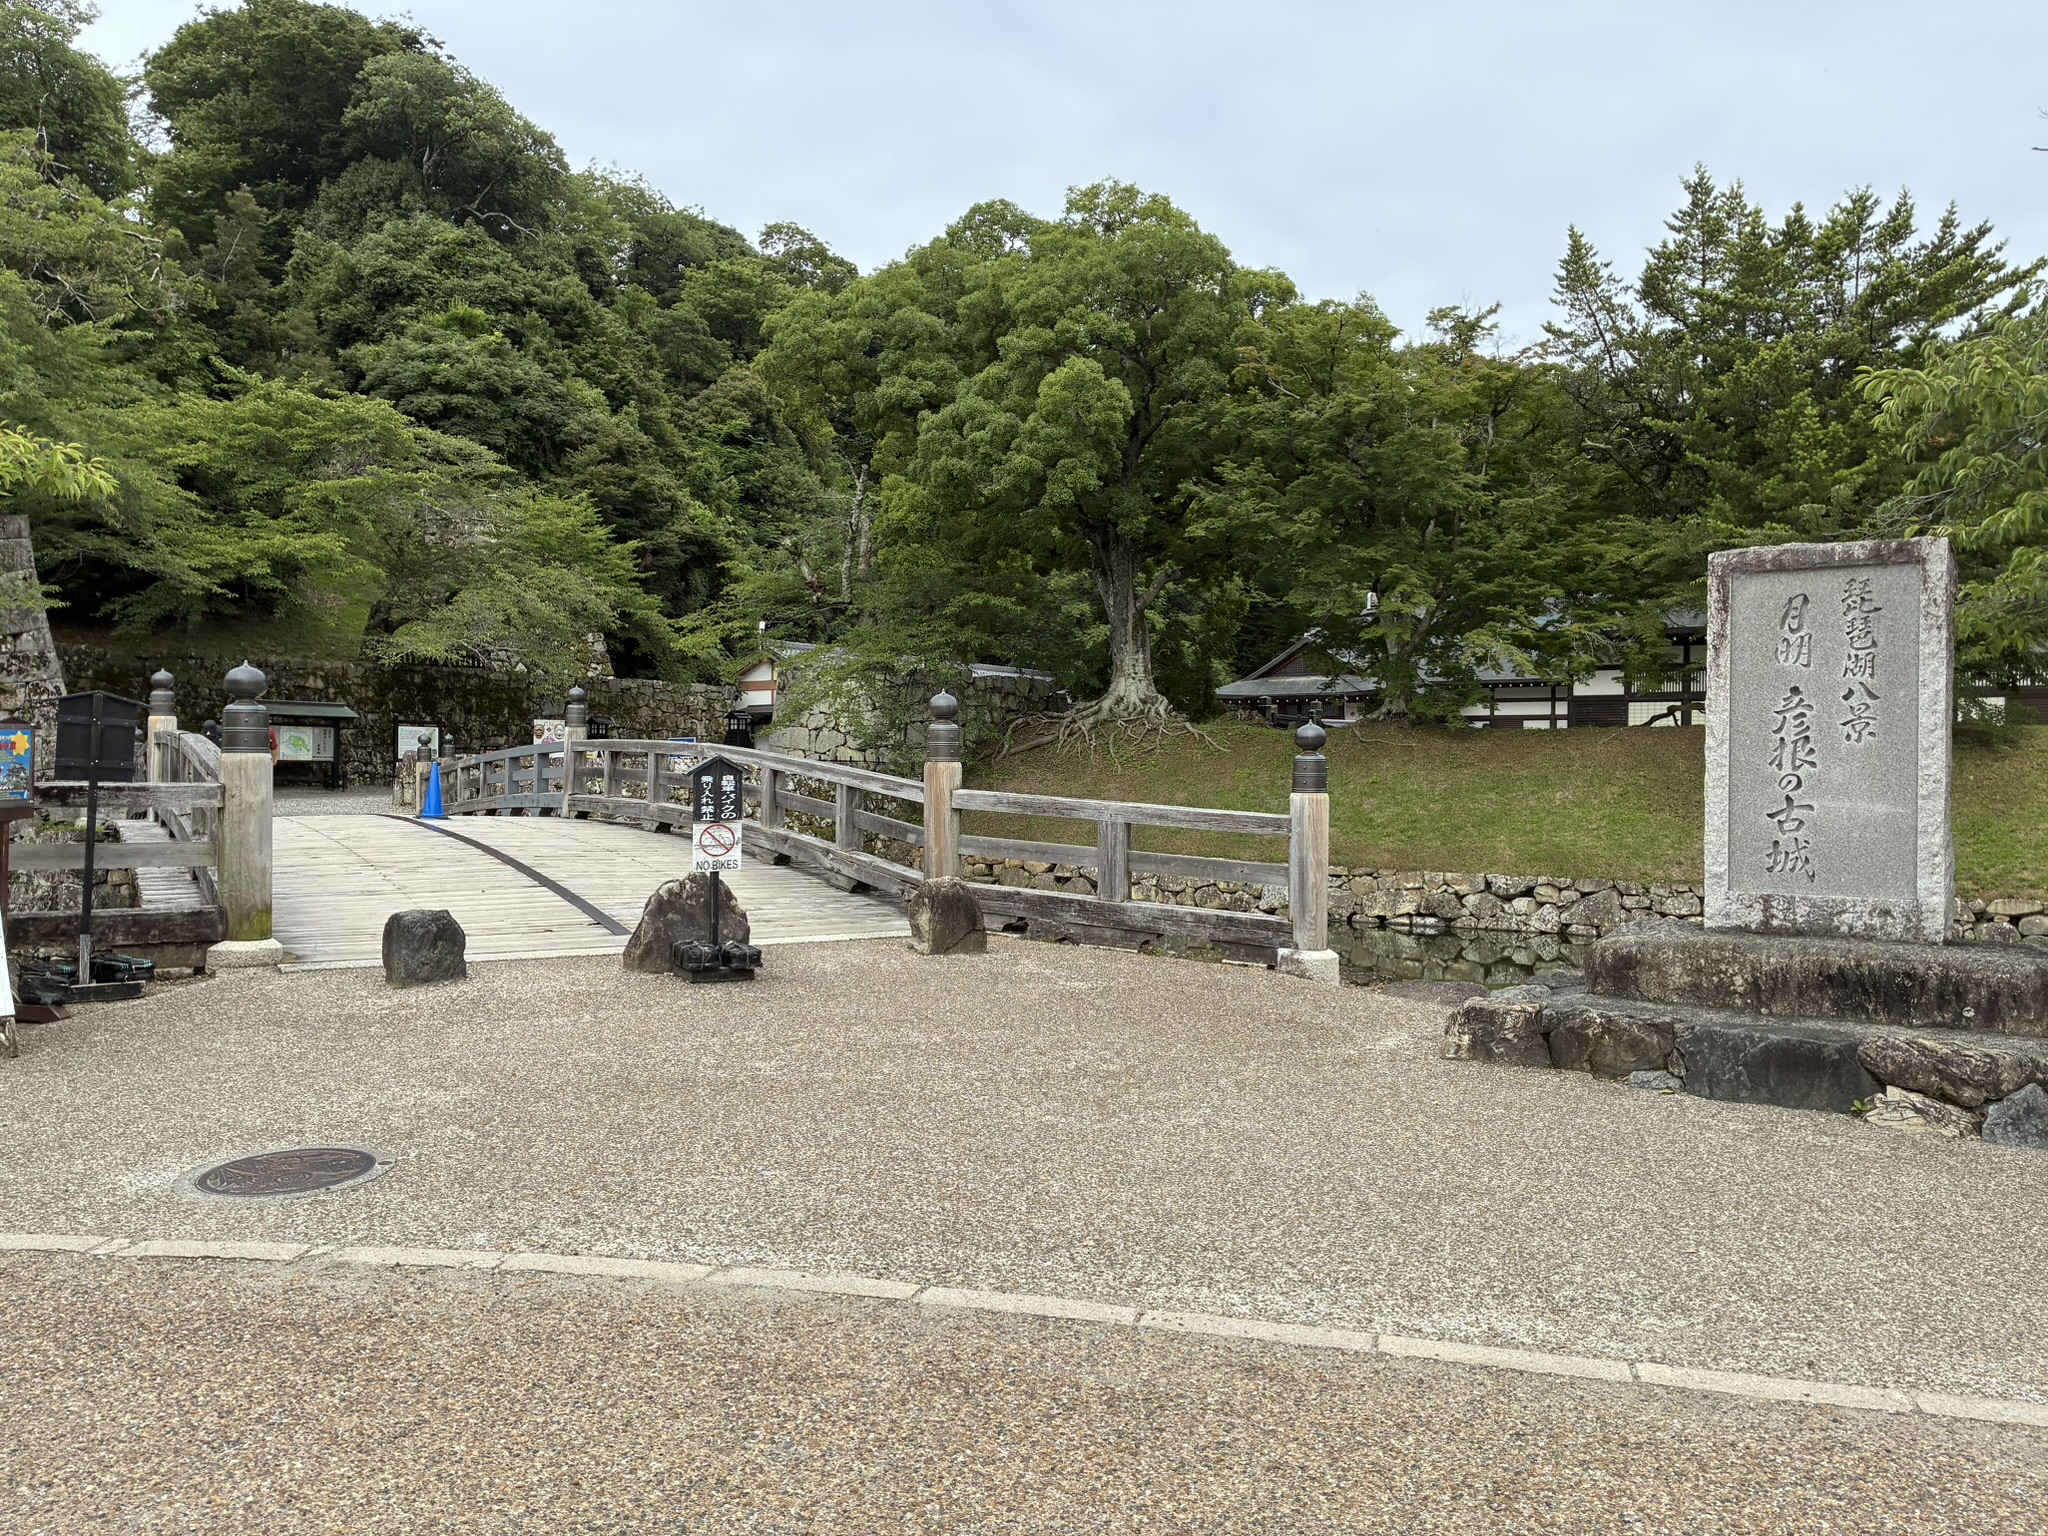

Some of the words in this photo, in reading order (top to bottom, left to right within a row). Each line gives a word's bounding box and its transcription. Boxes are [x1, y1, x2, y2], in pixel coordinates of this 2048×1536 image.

[1774, 593, 1812, 669] 月明
[1841, 578, 1883, 743] 琵琶湖八景
[700, 775, 715, 821] 乗り入れ禁止
[1765, 685, 1818, 884] 彦根の古城
[696, 860, 710, 871] NO
[712, 859, 739, 870] BIKES
